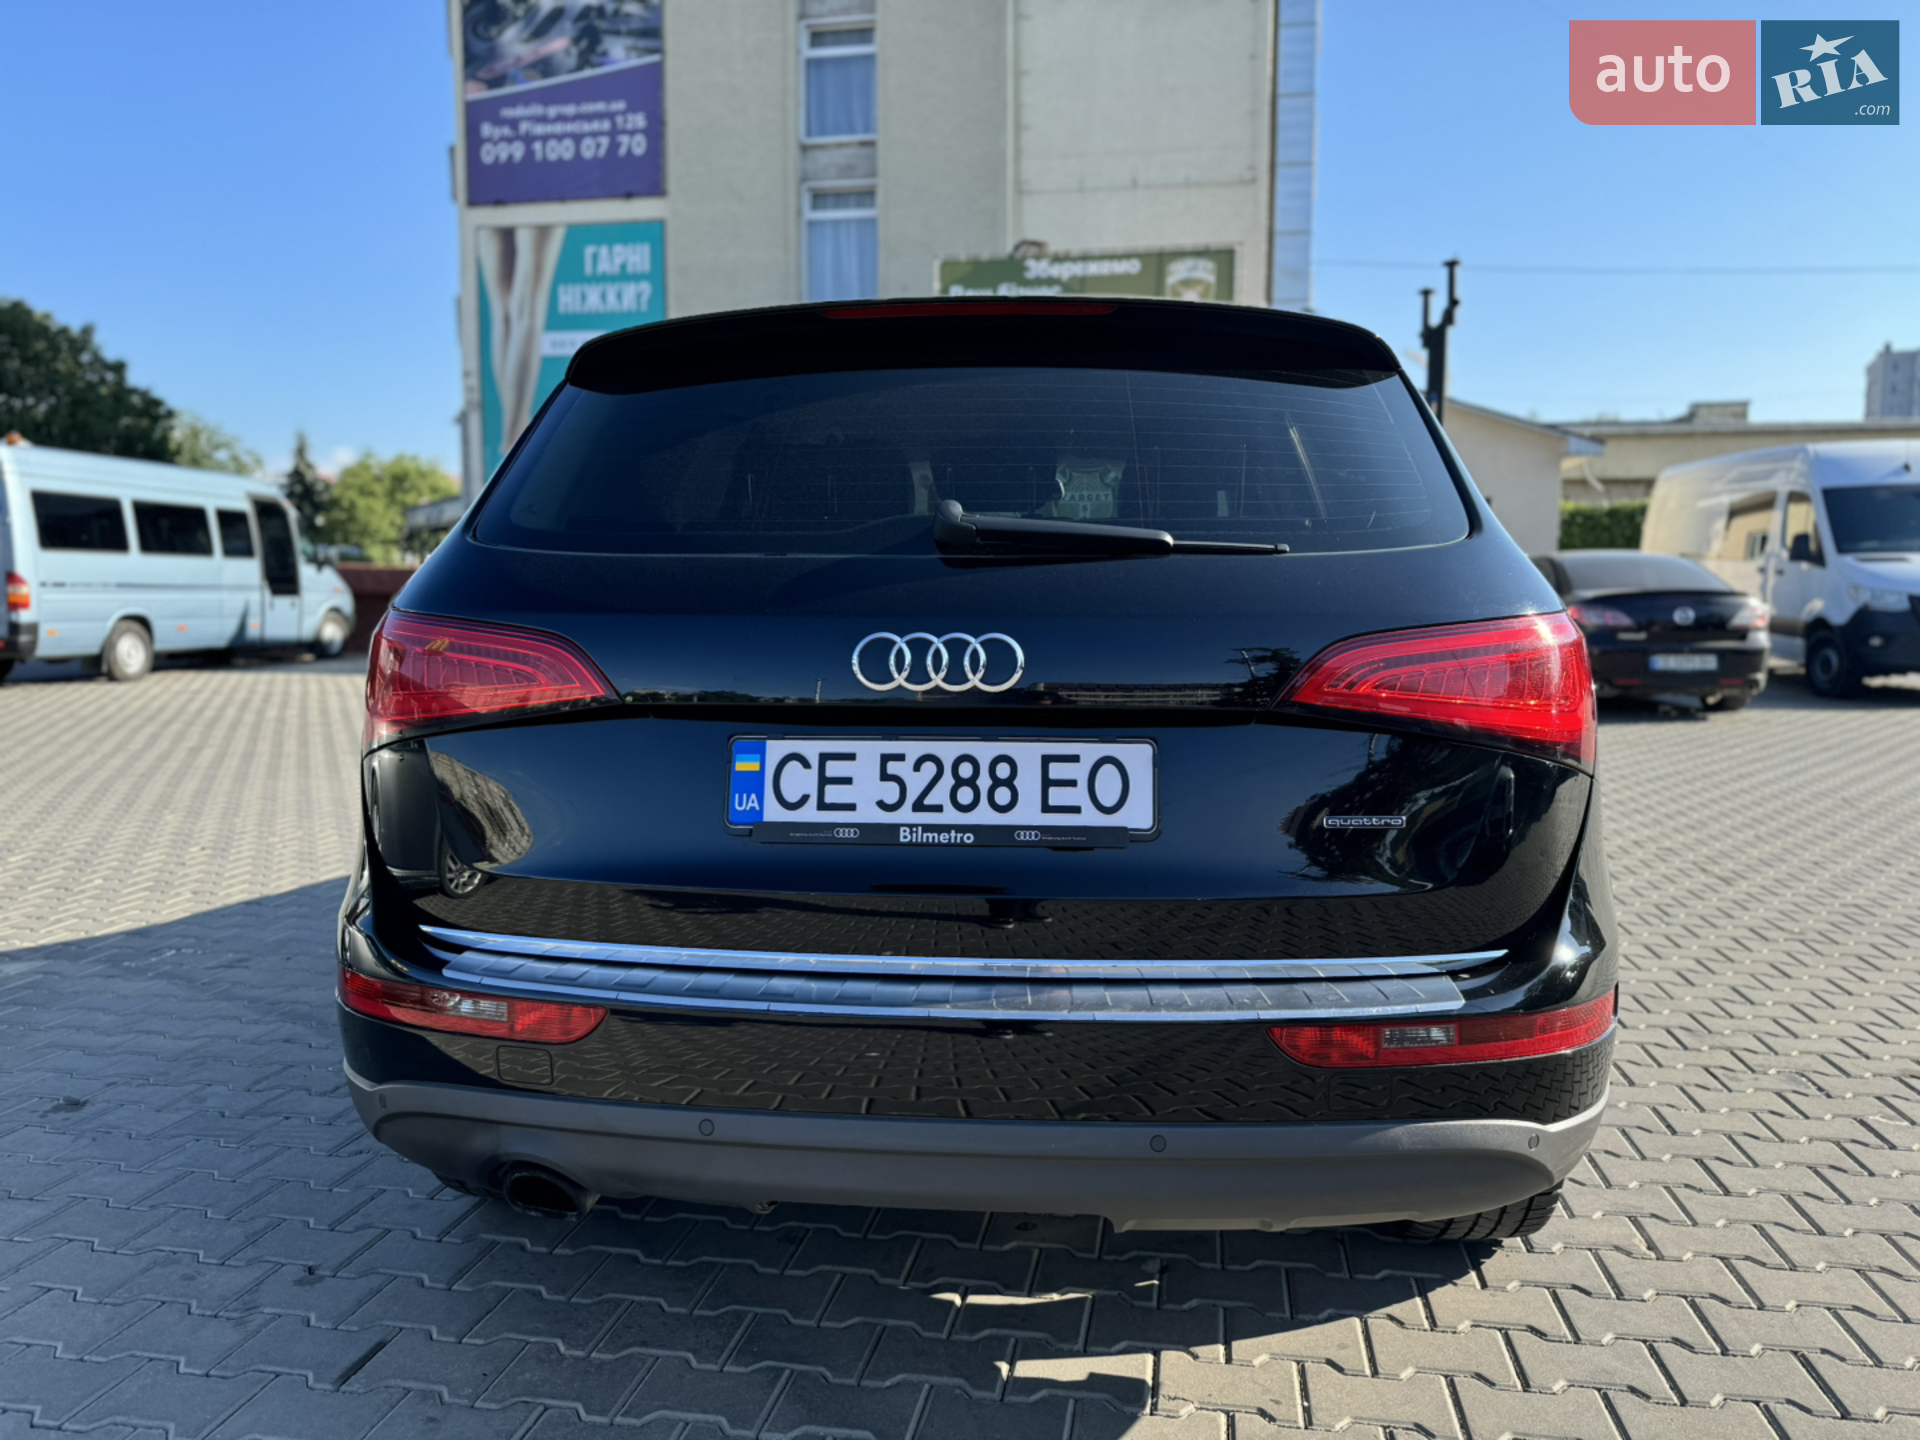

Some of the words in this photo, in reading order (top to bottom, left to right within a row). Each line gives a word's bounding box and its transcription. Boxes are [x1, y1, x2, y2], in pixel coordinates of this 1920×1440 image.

[479, 140, 525, 165] 099
[531, 137, 576, 162] 100
[579, 135, 611, 160] 07
[616, 132, 648, 157] 70
[585, 243, 651, 276] ГАРНІ
[558, 281, 652, 314] НІЖКИ?
[772, 752, 857, 812] CE
[875, 753, 1020, 814] 5288
[1040, 754, 1131, 816] EO
[735, 793, 760, 811] UA
[899, 826, 975, 845] Bilmetro
[1328, 818, 1402, 826] quattro
